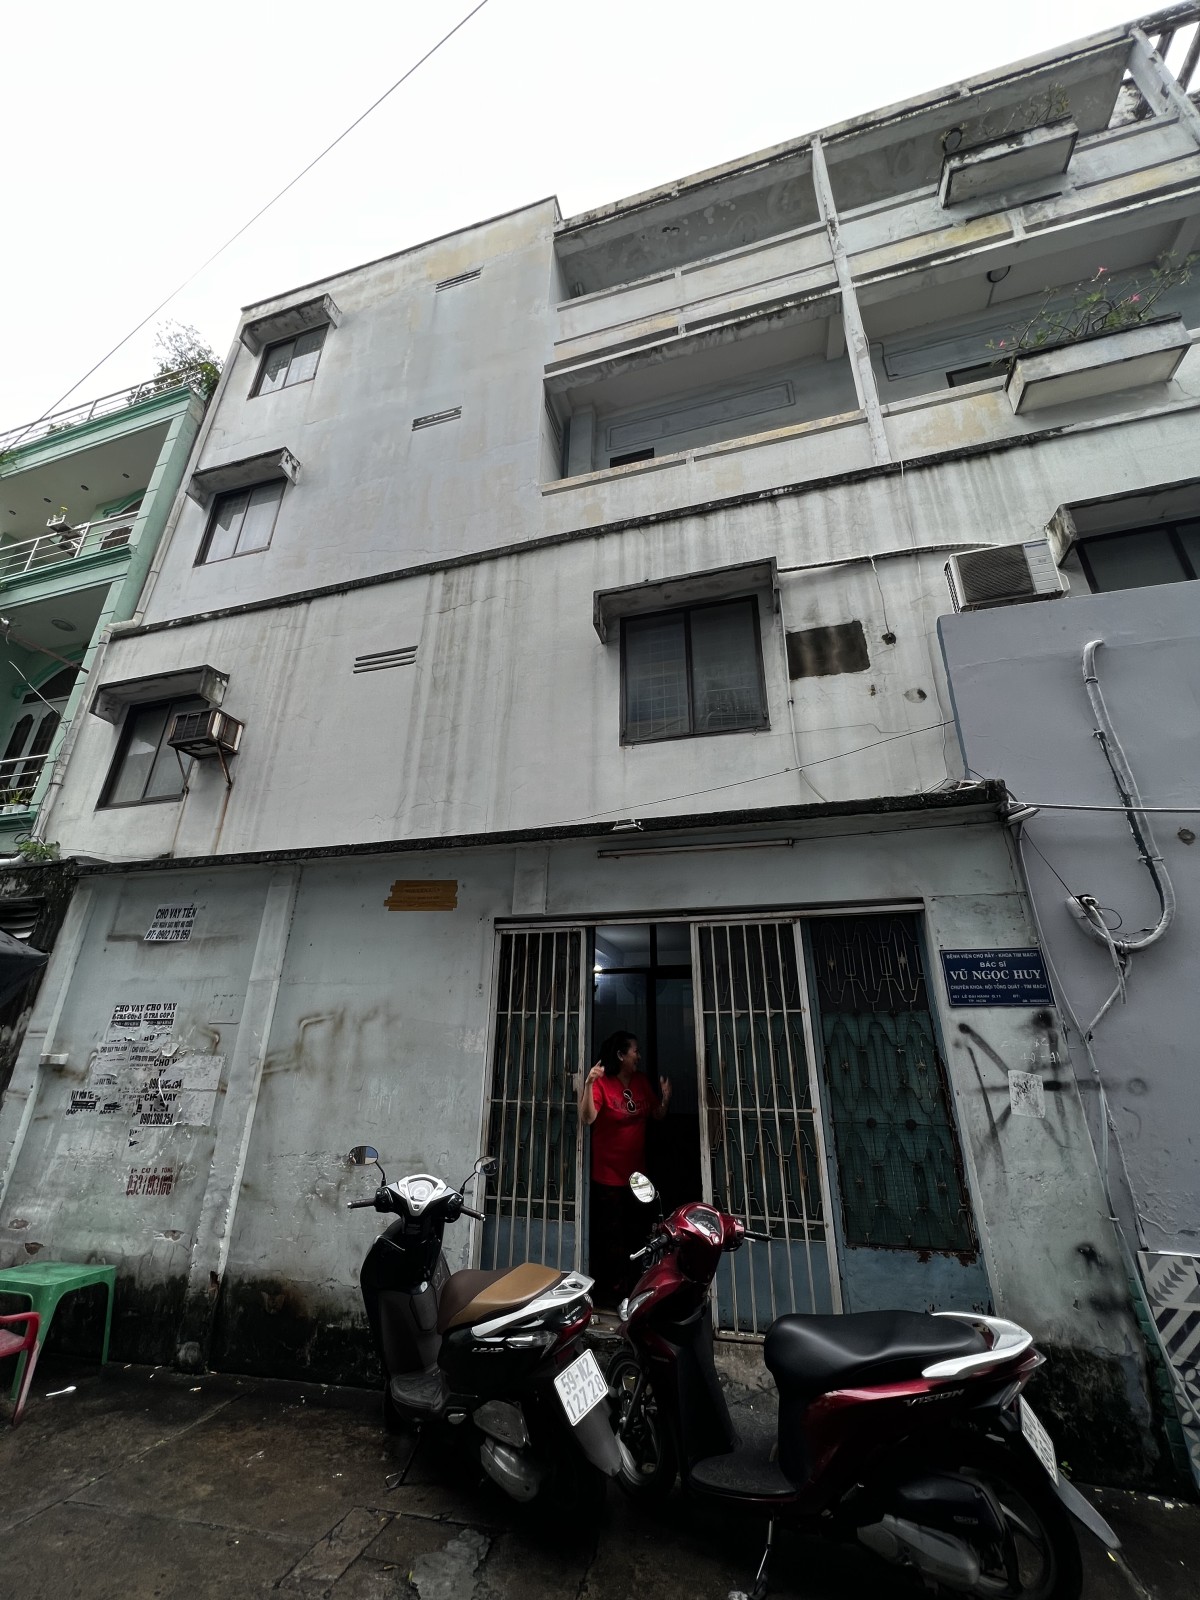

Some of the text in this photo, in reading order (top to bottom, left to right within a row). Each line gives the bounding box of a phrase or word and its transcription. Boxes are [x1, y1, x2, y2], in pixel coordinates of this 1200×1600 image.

[155, 908, 169, 919] CHO
[169, 908, 182, 918] VAY
[949, 968, 1041, 982] VŨ NGỌC HUY
[131, 1004, 145, 1012] VAY
[146, 1003, 178, 1011] CHO VAY
[153, 1058, 169, 1067] CHO
[144, 1093, 160, 1102] CH
[566, 1374, 604, 1420] 127.28
[904, 1388, 965, 1407] VISION
